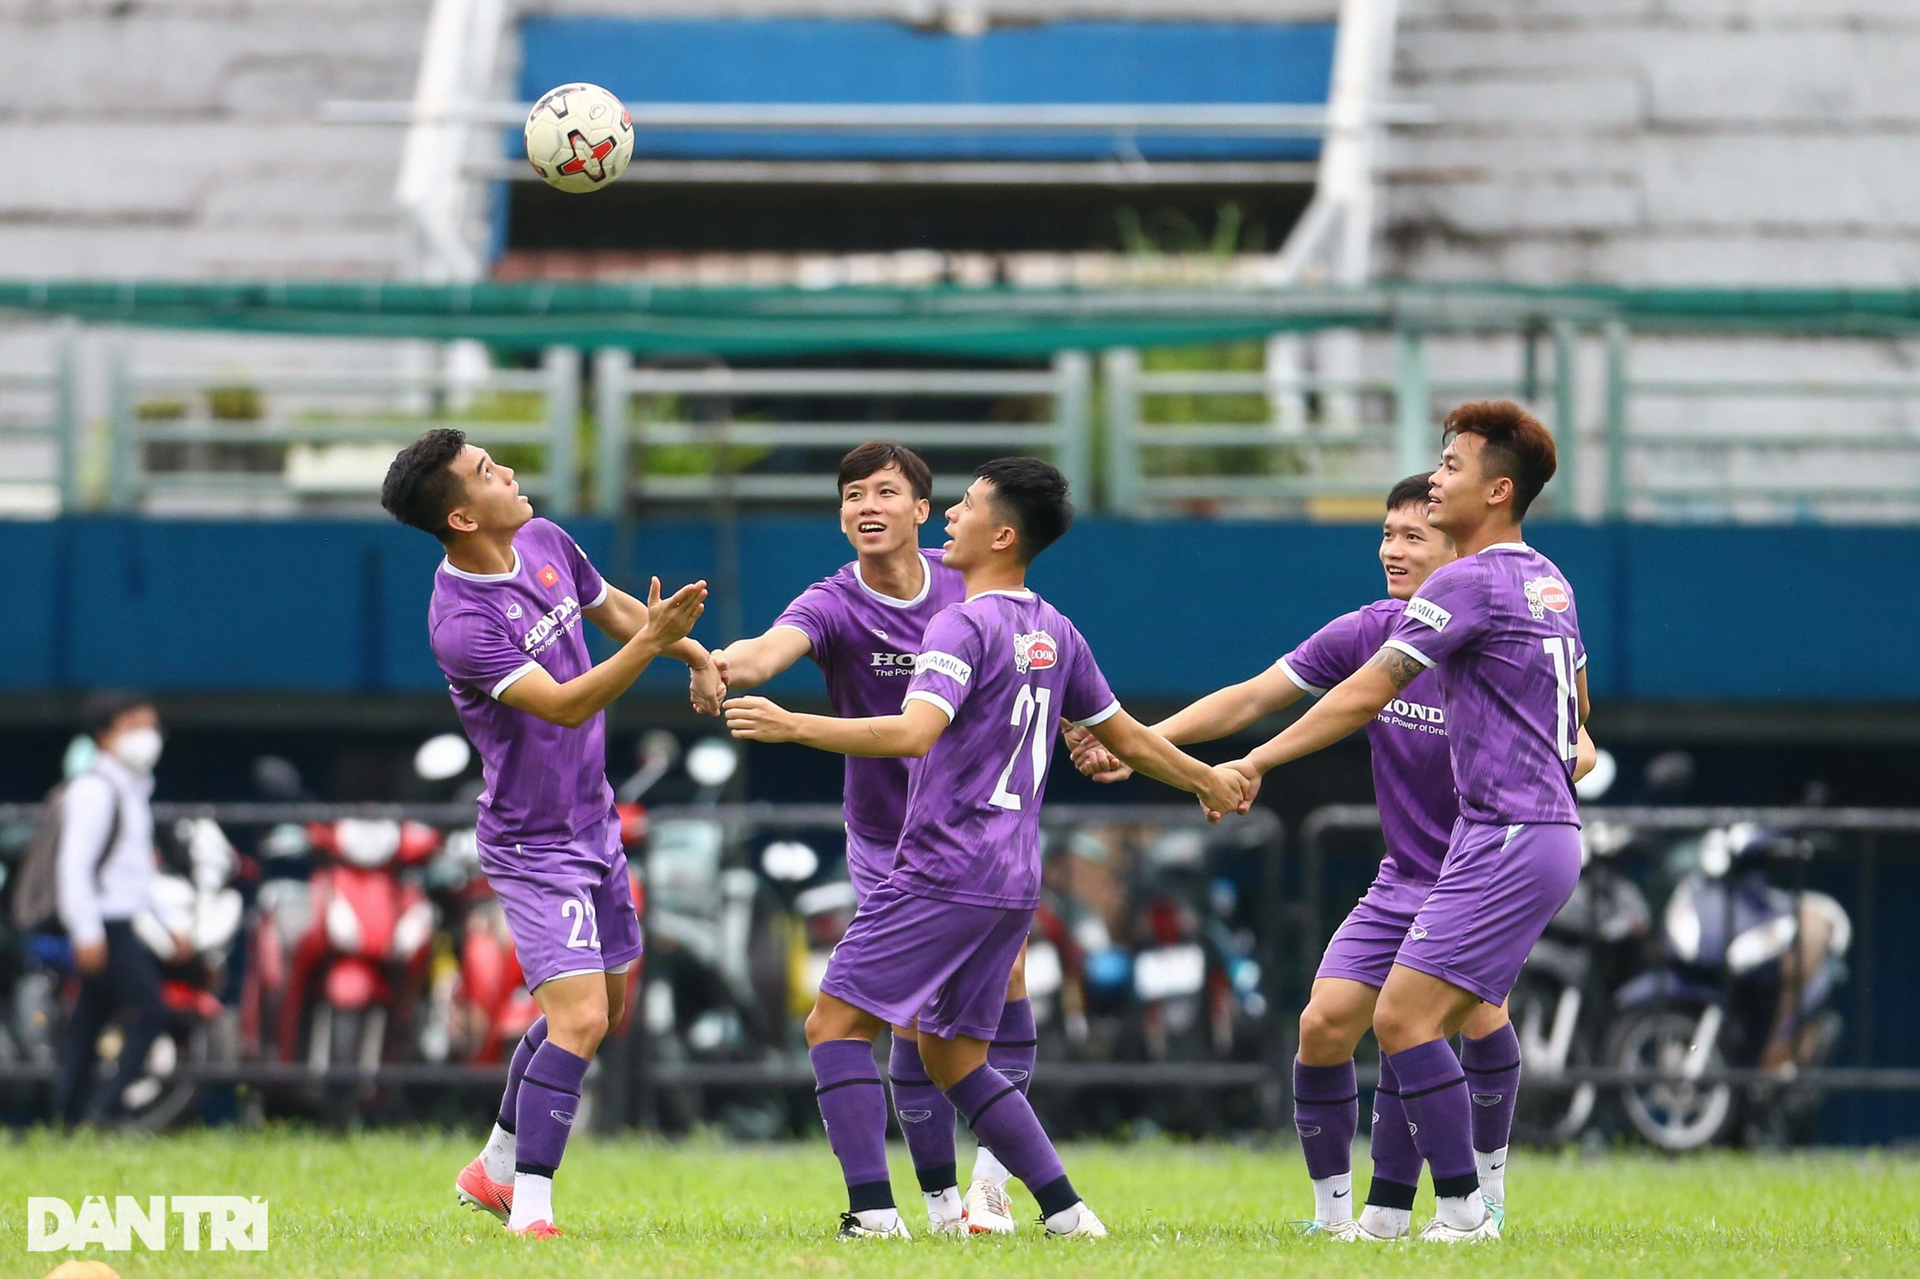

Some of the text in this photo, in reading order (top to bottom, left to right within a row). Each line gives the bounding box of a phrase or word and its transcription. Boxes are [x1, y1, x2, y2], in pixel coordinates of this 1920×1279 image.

[525, 596, 578, 651] HONDA
[870, 652, 919, 666] HO
[874, 669, 894, 677] The
[1374, 713, 1390, 723] he
[1391, 716, 1418, 730] Power
[1419, 724, 1428, 732] of
[988, 683, 1051, 810] 21
[561, 899, 602, 948] 22
